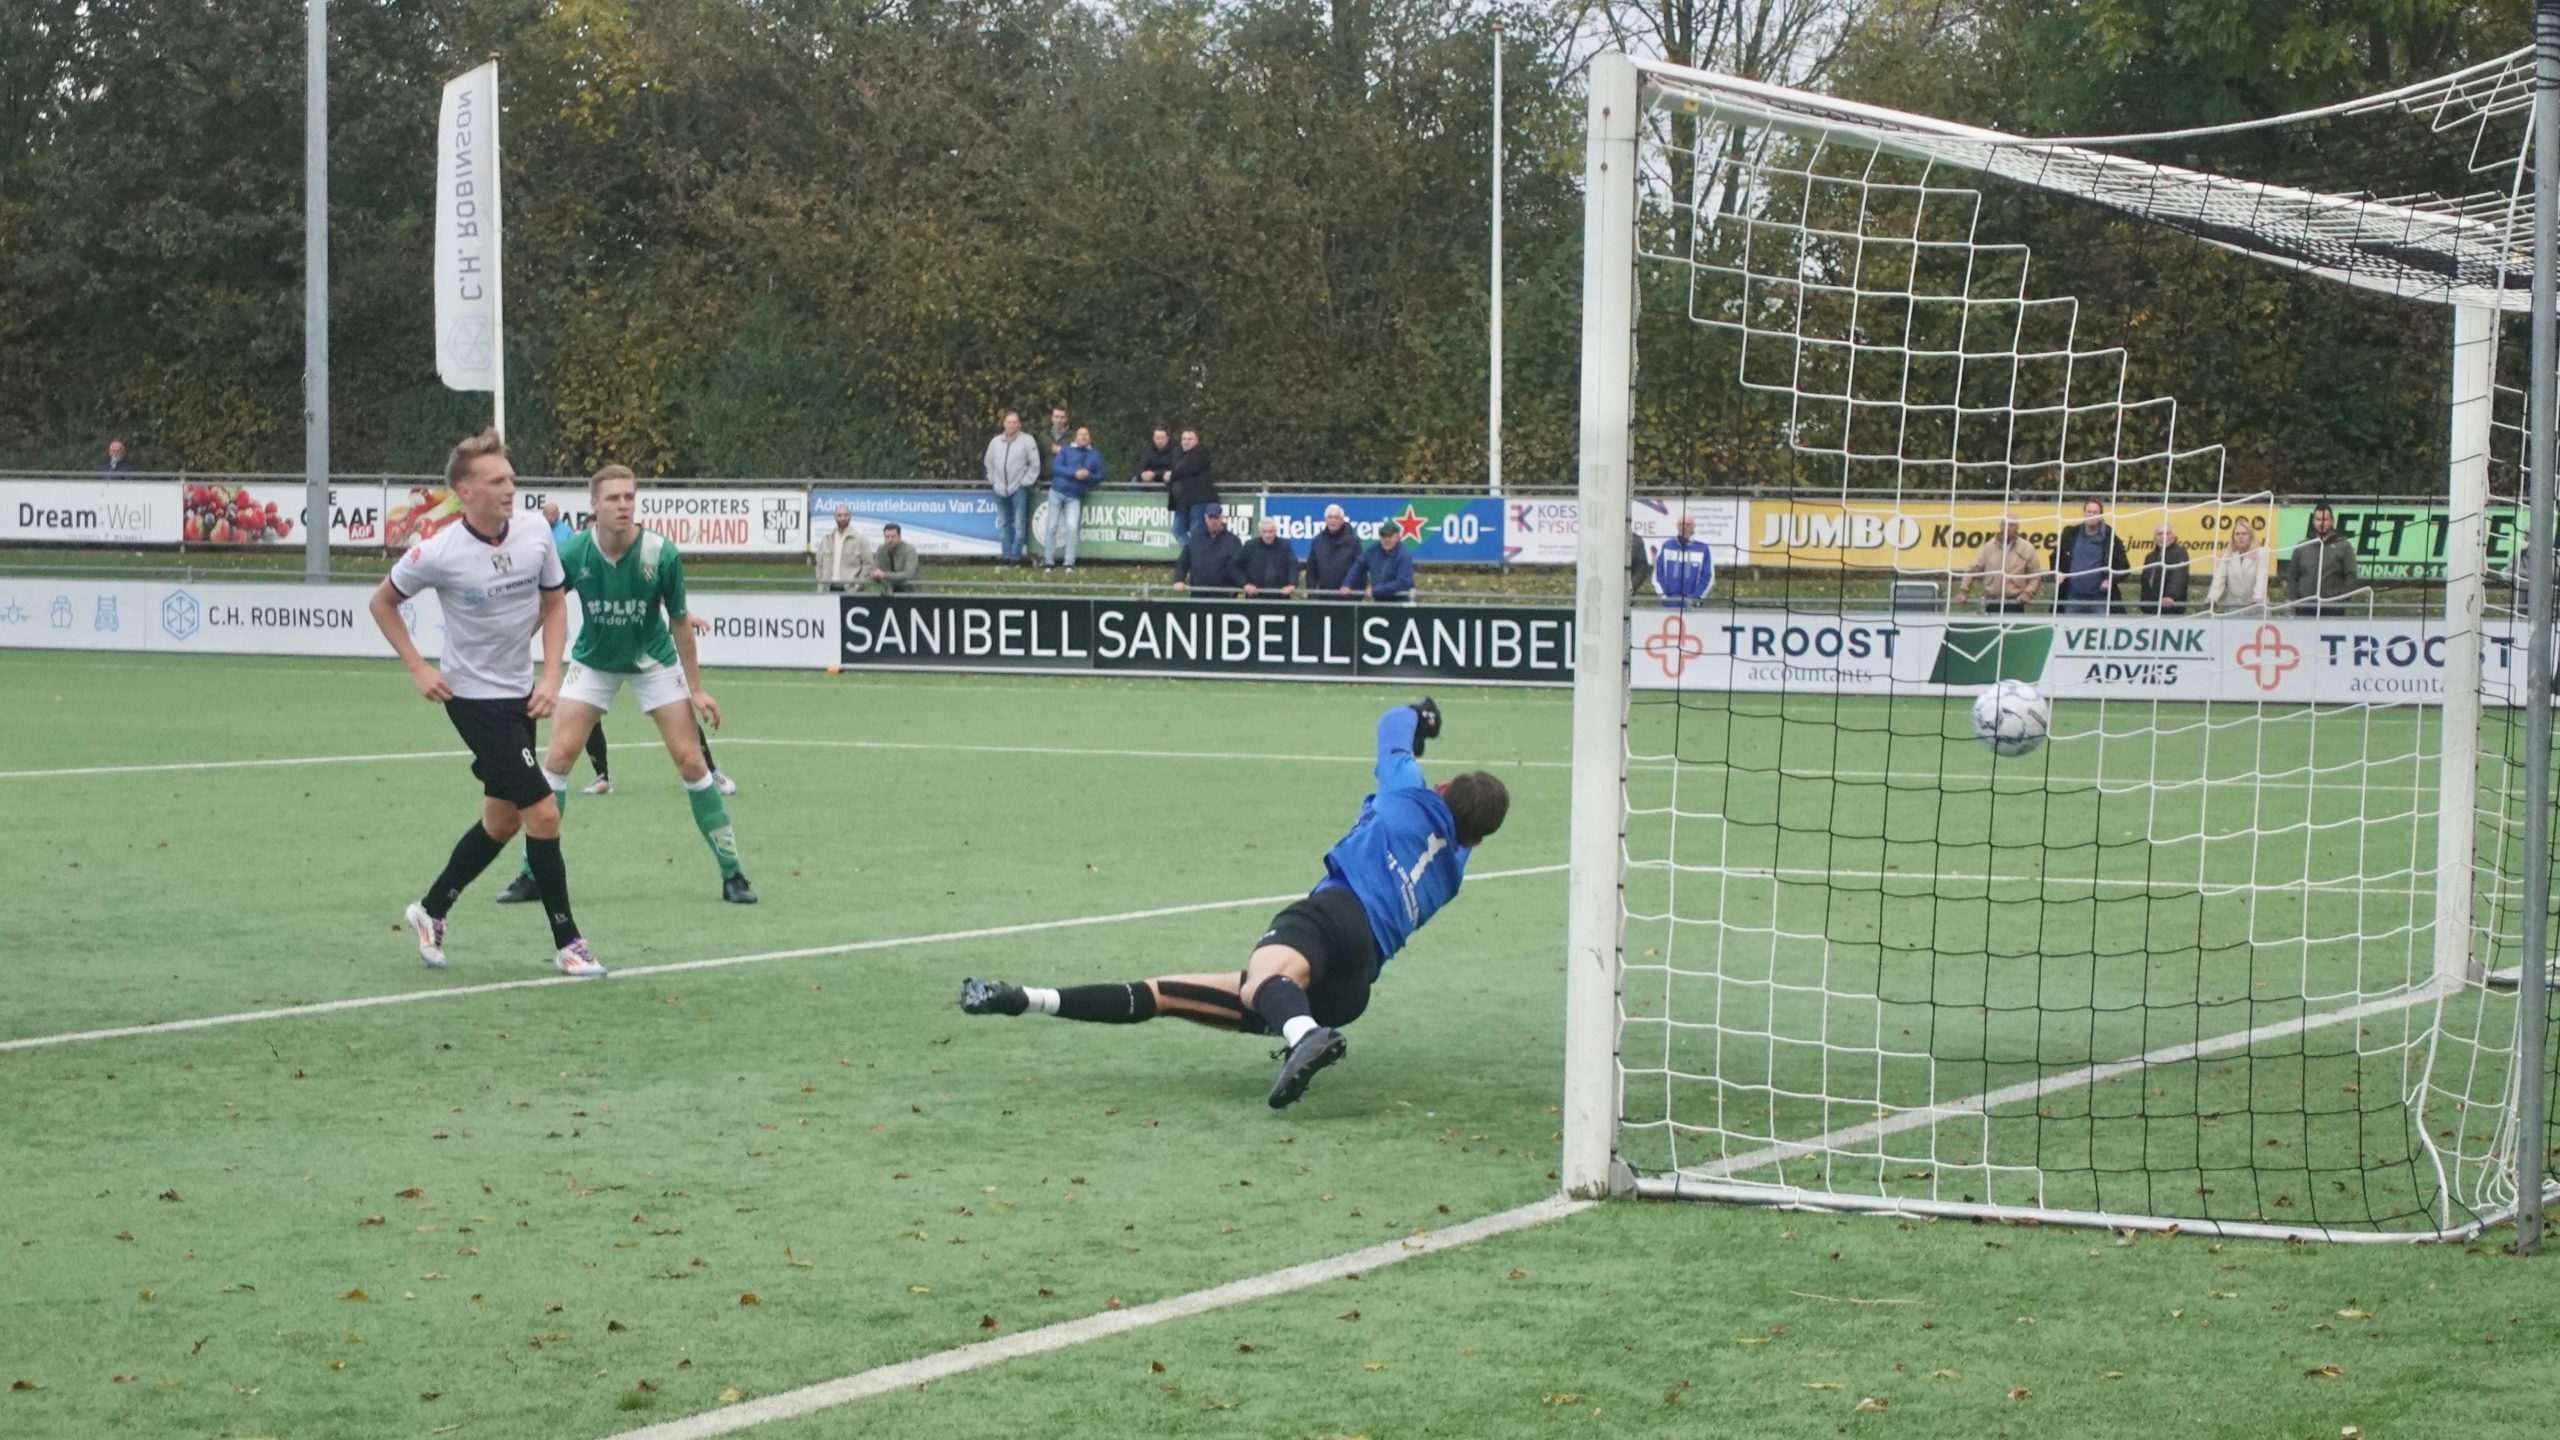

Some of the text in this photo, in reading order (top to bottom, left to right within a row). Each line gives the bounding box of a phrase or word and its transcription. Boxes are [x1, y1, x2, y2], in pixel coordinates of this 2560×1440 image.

[525, 494, 546, 509] DE
[641, 498, 750, 514] SUPPORTERS
[949, 499, 973, 513] Van
[766, 511, 799, 530] SHO
[1081, 505, 1114, 525] AJAX
[699, 518, 749, 545] HAND
[1758, 512, 1921, 549] JUMBO
[209, 606, 354, 629] C.H. ROBINSON
[713, 616, 826, 639] ROBINSON
[845, 606, 1088, 658] SANIBELL
[1098, 610, 1351, 665] SANIBELL
[1361, 616, 1576, 670] SANIBEL
[1721, 625, 1900, 659] TROOST
[1748, 666, 1873, 684] accountants
[2084, 663, 2179, 686] ADVIES
[522, 747, 534, 768] 8
